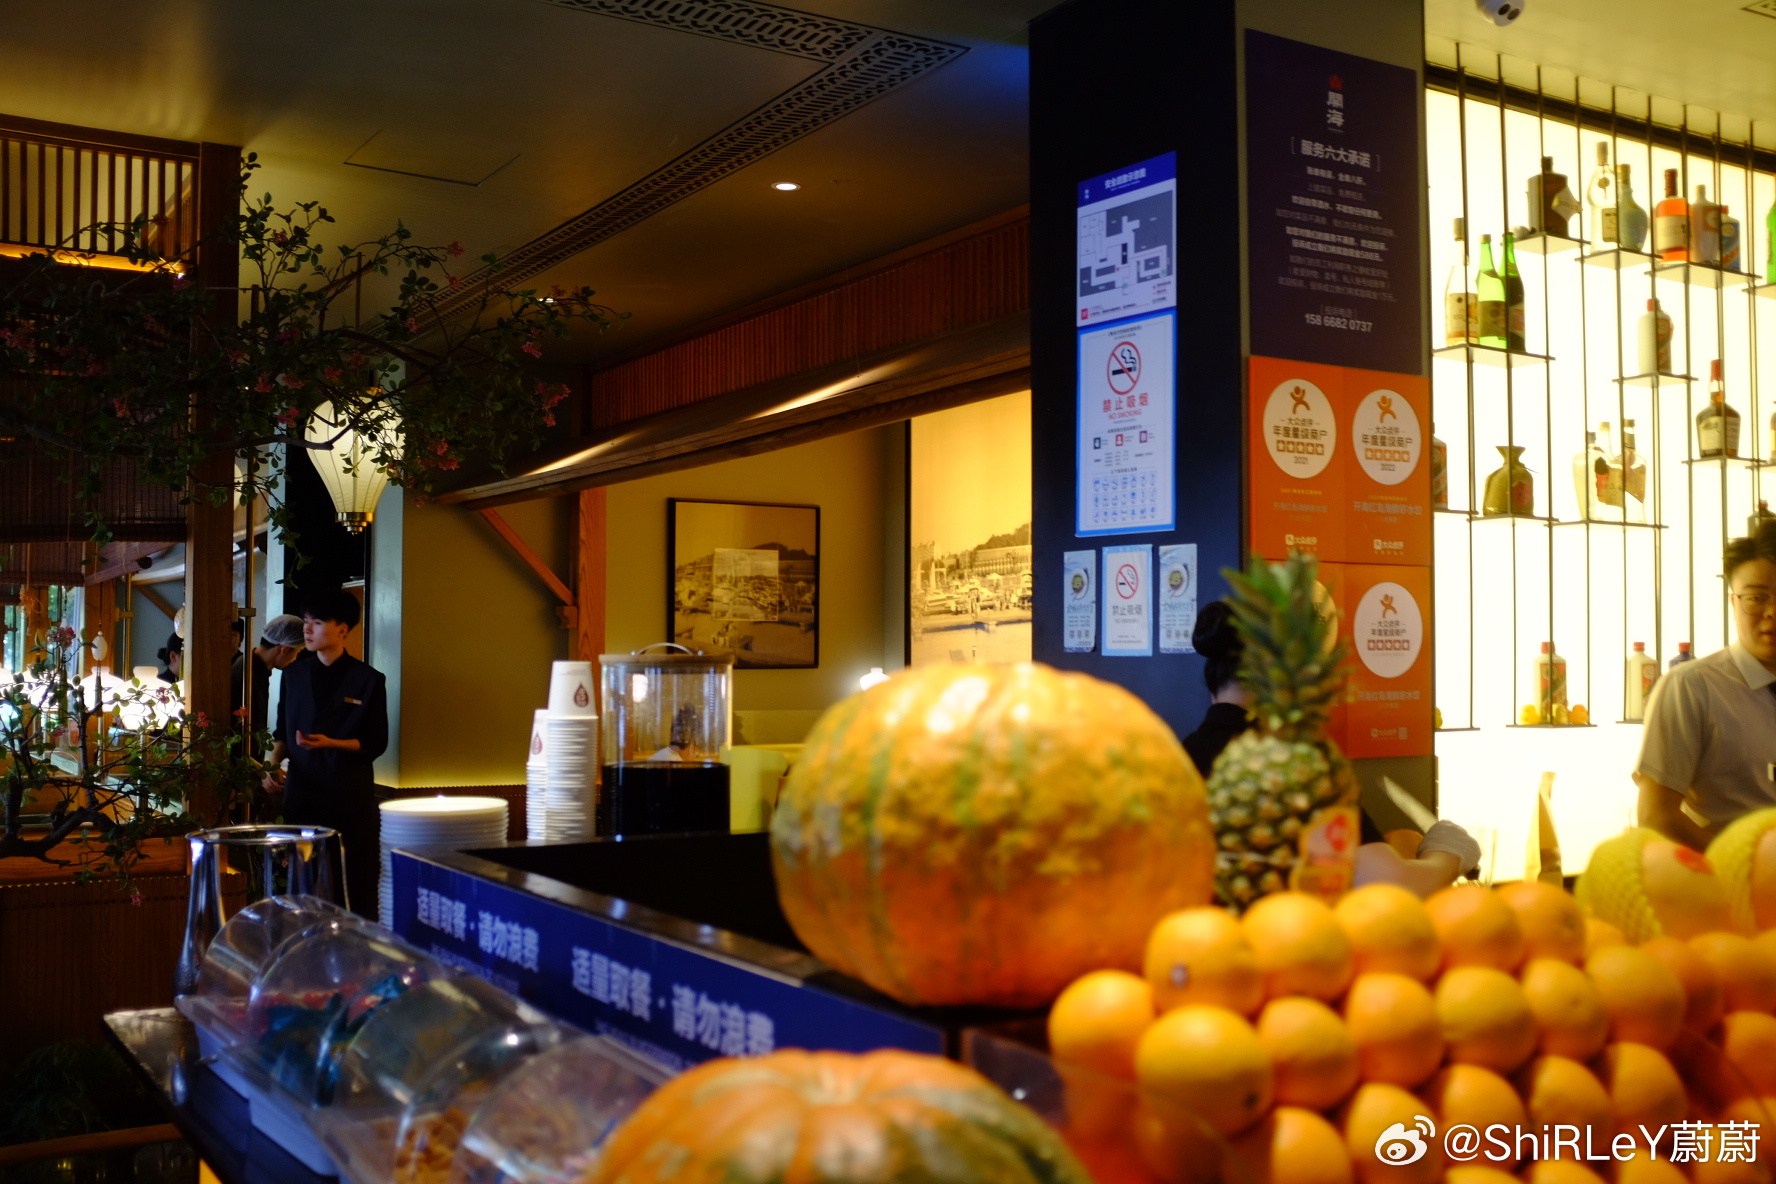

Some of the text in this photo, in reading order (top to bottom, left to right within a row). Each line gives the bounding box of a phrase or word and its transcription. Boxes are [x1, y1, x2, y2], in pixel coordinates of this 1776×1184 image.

[1300, 139, 1371, 168] 服务六大承诺
[1304, 313, 1322, 326] 158
[1349, 319, 1373, 332] 0737
[1103, 392, 1149, 413] 禁止吸烟
